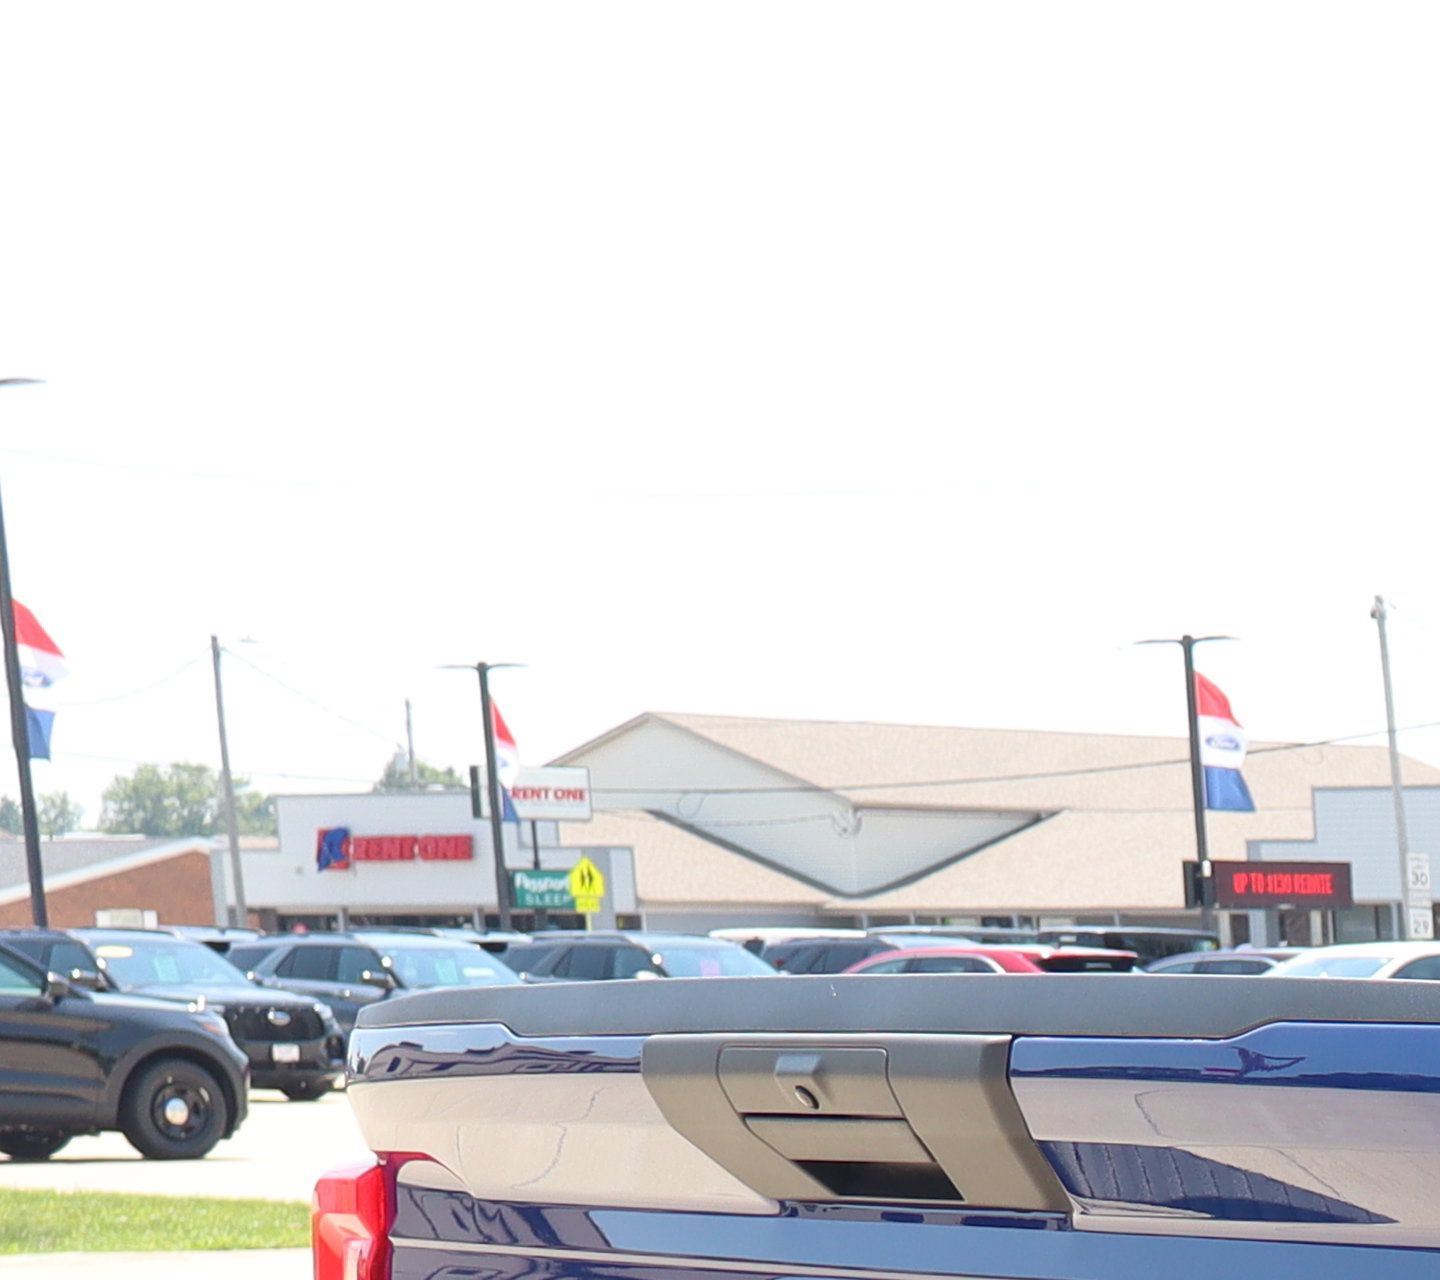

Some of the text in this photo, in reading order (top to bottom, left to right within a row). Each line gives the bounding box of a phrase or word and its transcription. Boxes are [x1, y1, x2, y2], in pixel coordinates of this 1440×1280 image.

[511, 786, 586, 801] RENT ONE
[352, 835, 474, 861] RENT ONE
[1233, 873, 1247, 895] UP
[1249, 873, 1265, 895] TO
